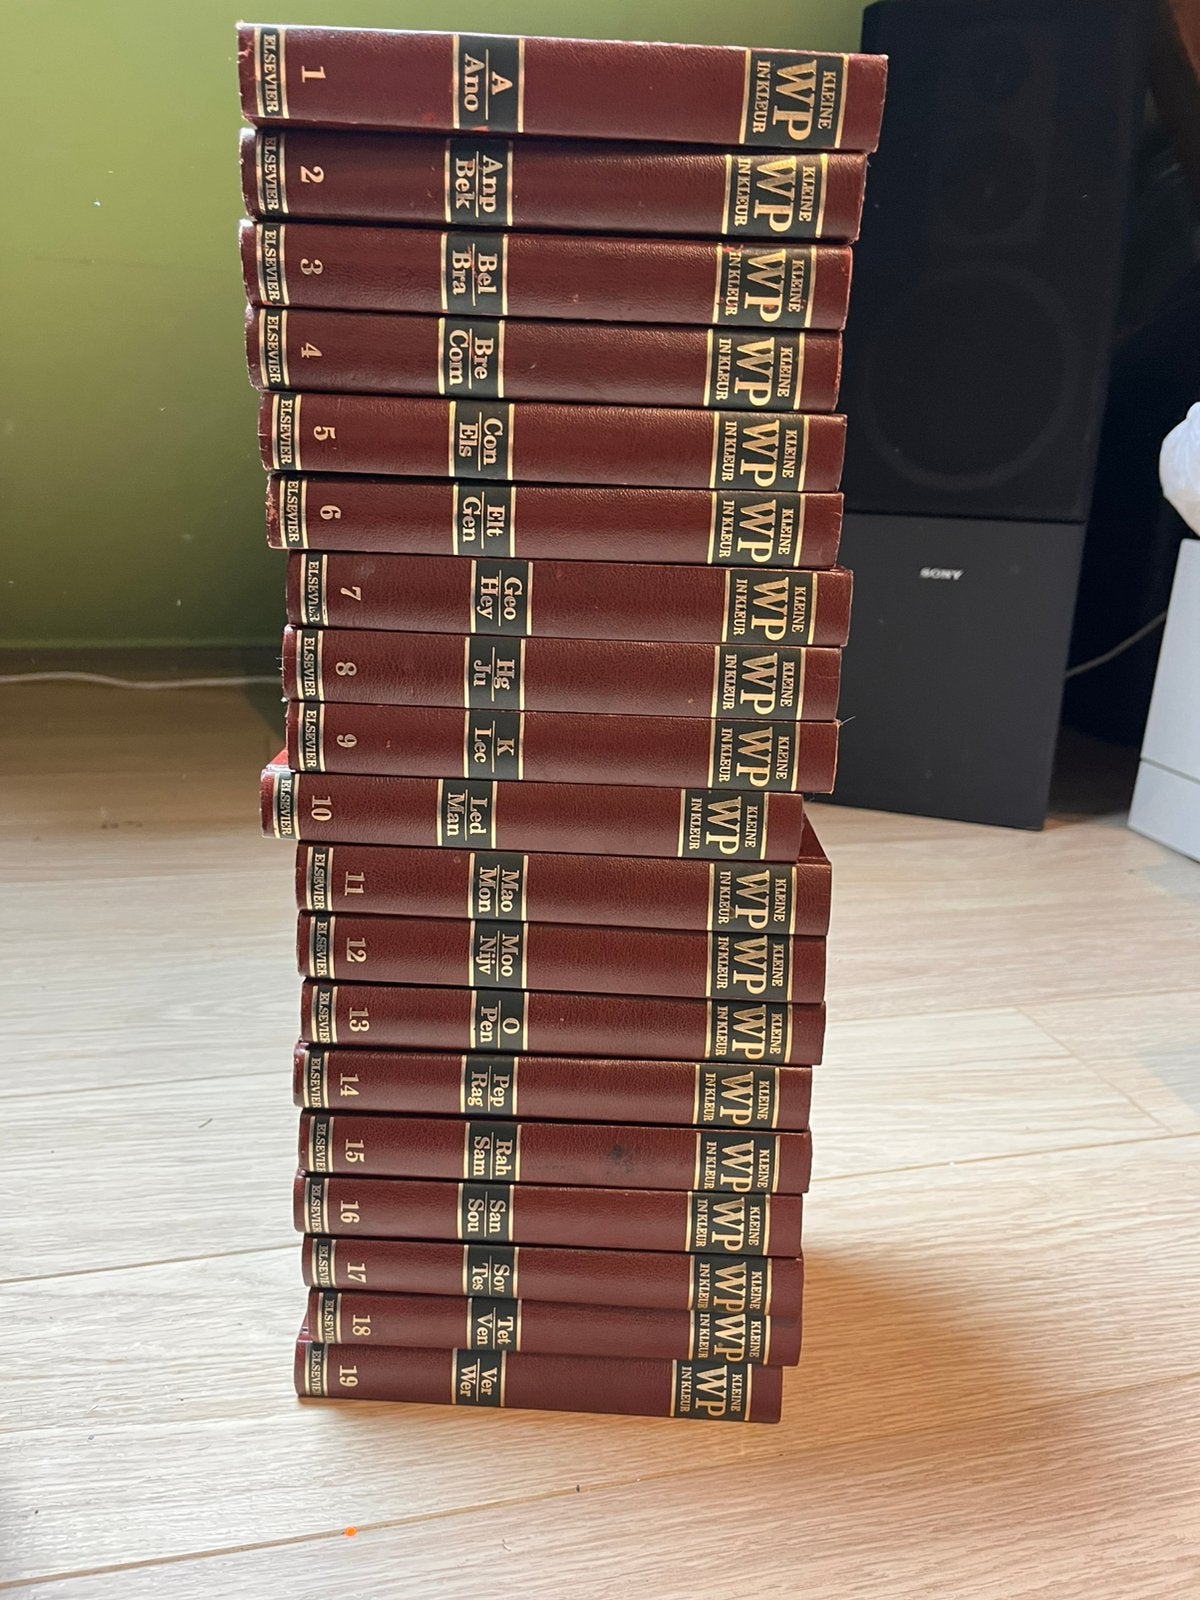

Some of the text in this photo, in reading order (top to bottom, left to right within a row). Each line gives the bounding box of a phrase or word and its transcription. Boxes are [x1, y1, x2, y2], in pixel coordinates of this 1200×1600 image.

[264, 34, 279, 113] ELSEVIER
[301, 66, 326, 83] 1
[464, 53, 485, 112] Ano
[492, 71, 513, 95] A
[753, 61, 771, 133] IN KLEUR
[773, 60, 817, 140] WP
[818, 71, 836, 130] KLEINE
[301, 166, 324, 183] 2
[455, 158, 475, 209] Bek
[480, 155, 503, 213] Anp
[734, 158, 751, 226] IN KLEUR
[754, 156, 796, 232] WP
[799, 166, 816, 222] KLEINE
[265, 230, 280, 304] ELSEVIER
[301, 259, 323, 275] 3
[452, 250, 471, 295] Bra
[478, 253, 498, 294] Bel
[725, 252, 741, 316] IN KLEUR
[744, 249, 786, 322] WP
[789, 259, 805, 312] KLEINE
[267, 315, 281, 383] ELSEVIER
[301, 343, 322, 358] 4
[449, 329, 469, 385] Com
[474, 337, 494, 379] Bre
[716, 338, 731, 400] IN KLEUR
[735, 337, 775, 406] WP
[777, 347, 793, 397] KLEINE
[280, 399, 292, 464] ELSEVIER
[313, 426, 336, 441] 5
[459, 422, 478, 457] Els
[483, 418, 503, 465] Con
[722, 421, 737, 481] IN KLEUR
[740, 420, 780, 487] WP
[782, 429, 797, 478] KLEINE
[287, 481, 299, 542] ELSEVIER
[320, 505, 341, 520] 6
[463, 496, 481, 542] Gen
[486, 504, 505, 537] Elt
[719, 500, 734, 557] IN KLEUR
[737, 500, 776, 563] WP
[778, 508, 794, 555] KLEINE
[340, 586, 361, 601] 7
[477, 576, 498, 620] Hey
[504, 577, 522, 620] Geo
[734, 579, 748, 635] IN KLEUR
[751, 577, 789, 640] WP
[792, 586, 806, 633] KLEINE
[304, 637, 315, 696] ELSEVIER
[336, 662, 357, 676] 8
[474, 660, 491, 686] Ju
[494, 659, 514, 690] Hg
[723, 654, 737, 710] IN KLEUR
[740, 652, 778, 715] WP
[780, 661, 794, 707] KLEINE
[306, 710, 316, 768] ELSEVIER
[337, 734, 357, 748] 9
[474, 728, 492, 763] Lec
[497, 738, 514, 756] K
[719, 728, 733, 782] IN KLEUR
[736, 726, 773, 787] WP
[776, 736, 789, 780] KLEINE
[281, 779, 292, 834] ELSEVIER
[311, 795, 332, 821] 10
[447, 792, 465, 836] Man
[470, 797, 487, 834] Led
[689, 798, 702, 849] IN KLEUR
[706, 796, 741, 855] WP
[745, 806, 758, 848] KLEINE
[314, 854, 325, 909] ELSEVIER
[345, 871, 365, 896] 11
[478, 867, 496, 912] Mon
[501, 870, 519, 912] Mao
[718, 871, 731, 924] IN KLEUR
[735, 870, 770, 929] WP
[774, 879, 786, 922] KLEINE
[316, 922, 328, 976] ELSEVIER
[347, 938, 366, 962] 12
[476, 936, 496, 974] Nijv
[501, 934, 519, 977] Moo
[717, 936, 729, 989] IN KLEUR
[733, 935, 768, 994] WP
[772, 944, 784, 986] KLEINE
[349, 1007, 369, 1031] 13
[480, 1006, 497, 1043] Pen
[503, 1018, 520, 1034] O
[716, 1006, 728, 1056] IN KLEUR
[732, 1004, 766, 1059] WP
[770, 1013, 782, 1054] KLEINE
[340, 1073, 359, 1096] 14
[468, 1071, 488, 1107] Rag
[490, 1074, 509, 1107] Pep
[704, 1073, 716, 1121] IN KLEUR
[720, 1071, 754, 1125] WP
[757, 1080, 769, 1120] KLEINE
[345, 1139, 364, 1162] 15
[474, 1136, 490, 1176] Sam
[496, 1139, 513, 1176] Rah
[704, 1141, 717, 1189] IN KLEUR
[720, 1140, 754, 1192] WP
[757, 1149, 770, 1188] KLEINE
[340, 1200, 360, 1223] 16
[468, 1199, 484, 1232] Sou
[489, 1200, 506, 1233] San
[696, 1199, 708, 1247] IN KLEUR
[712, 1197, 744, 1251] WP
[749, 1206, 760, 1246] KLEINE
[348, 1262, 366, 1283] 17
[472, 1263, 488, 1291] Tes
[494, 1264, 510, 1292] Sov
[700, 1263, 710, 1278] IN
[714, 1262, 746, 1312] WP
[750, 1271, 762, 1309] KLEINE
[352, 1314, 371, 1336] 18
[477, 1313, 493, 1345] Ven
[497, 1317, 513, 1345] Tet
[698, 1313, 710, 1358] IN KLEUR
[714, 1314, 746, 1362] WP
[750, 1320, 761, 1358] KLEINE
[339, 1365, 358, 1387] 19
[460, 1364, 477, 1397] Wer
[481, 1367, 497, 1395] Ver
[680, 1366, 692, 1412] IN KLEUR
[695, 1365, 727, 1417] WP
[731, 1373, 742, 1412] KLEINE
